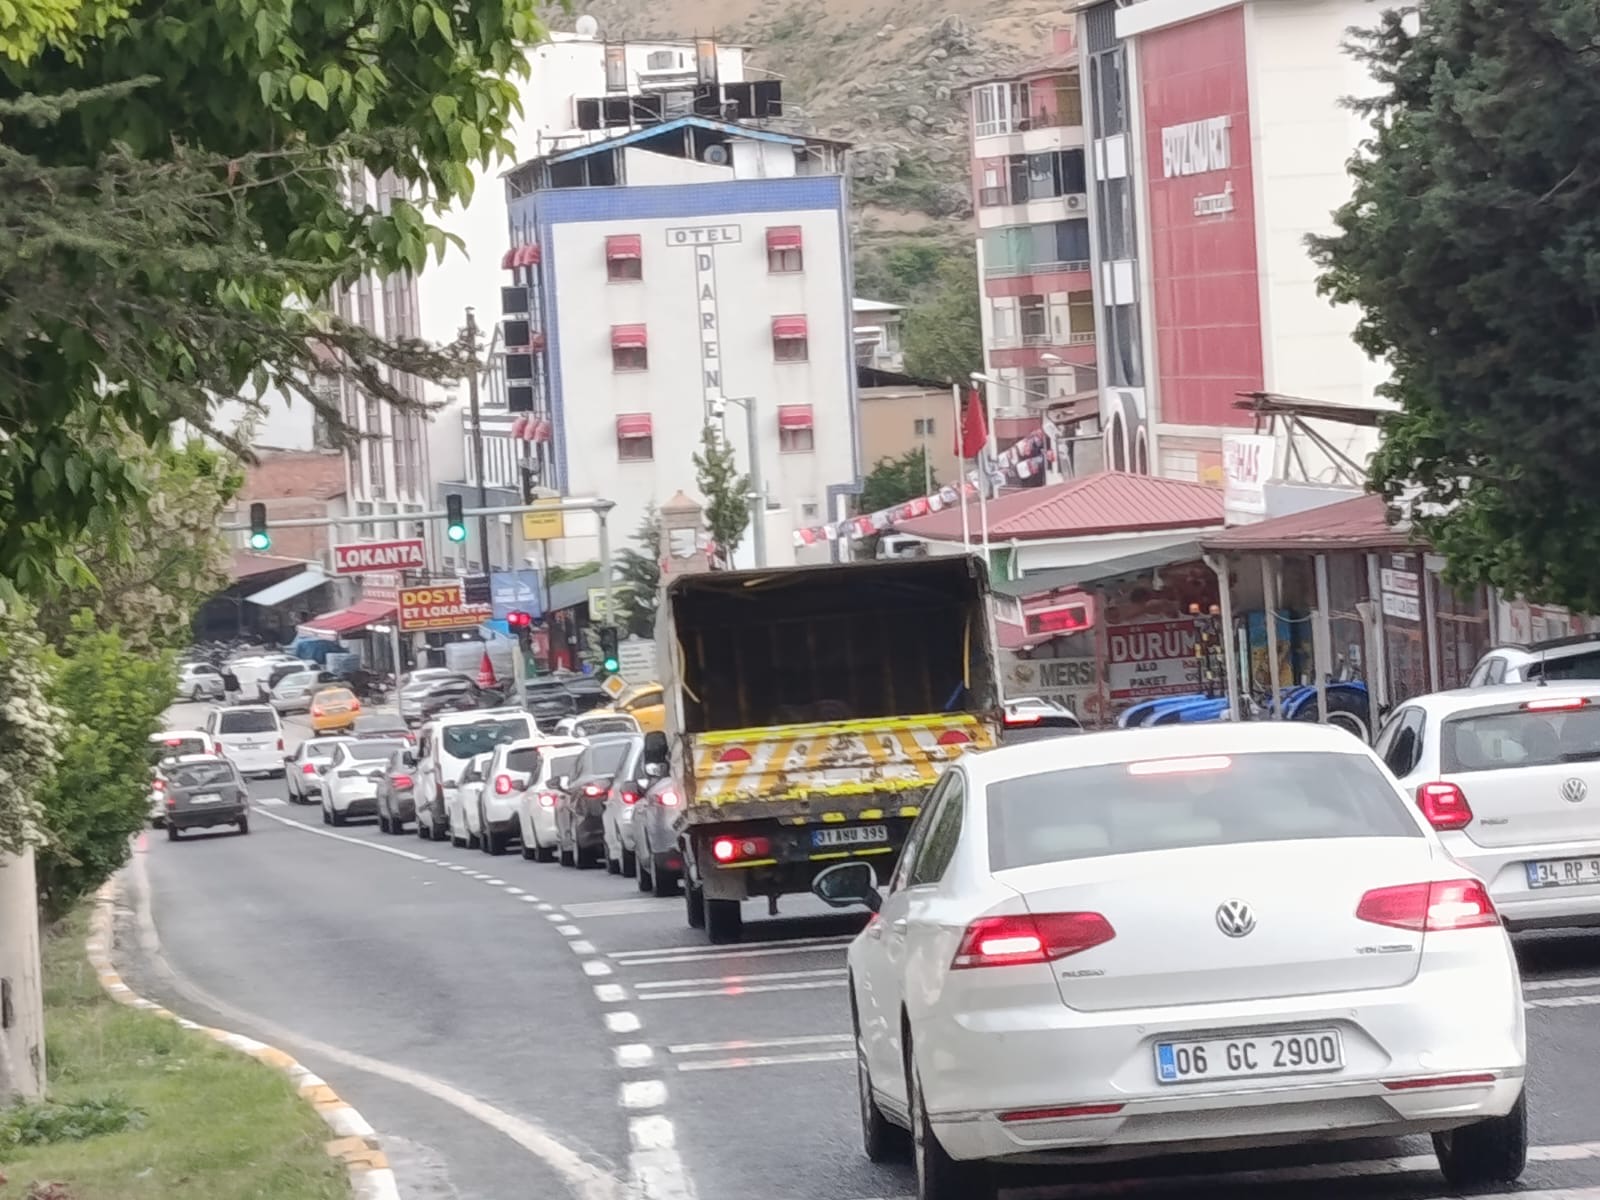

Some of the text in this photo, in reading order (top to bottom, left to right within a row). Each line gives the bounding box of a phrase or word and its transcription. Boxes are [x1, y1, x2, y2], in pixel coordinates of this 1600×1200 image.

[675, 228, 733, 243] OTEL
[336, 545, 423, 568] LOKANTA
[402, 588, 458, 606] DOST
[403, 607, 419, 619] ET
[1129, 675, 1168, 687] PAKET
[1539, 864, 1558, 880] 34
[1564, 861, 1583, 880] RP
[1176, 1035, 1336, 1075] 06 GC 2900
